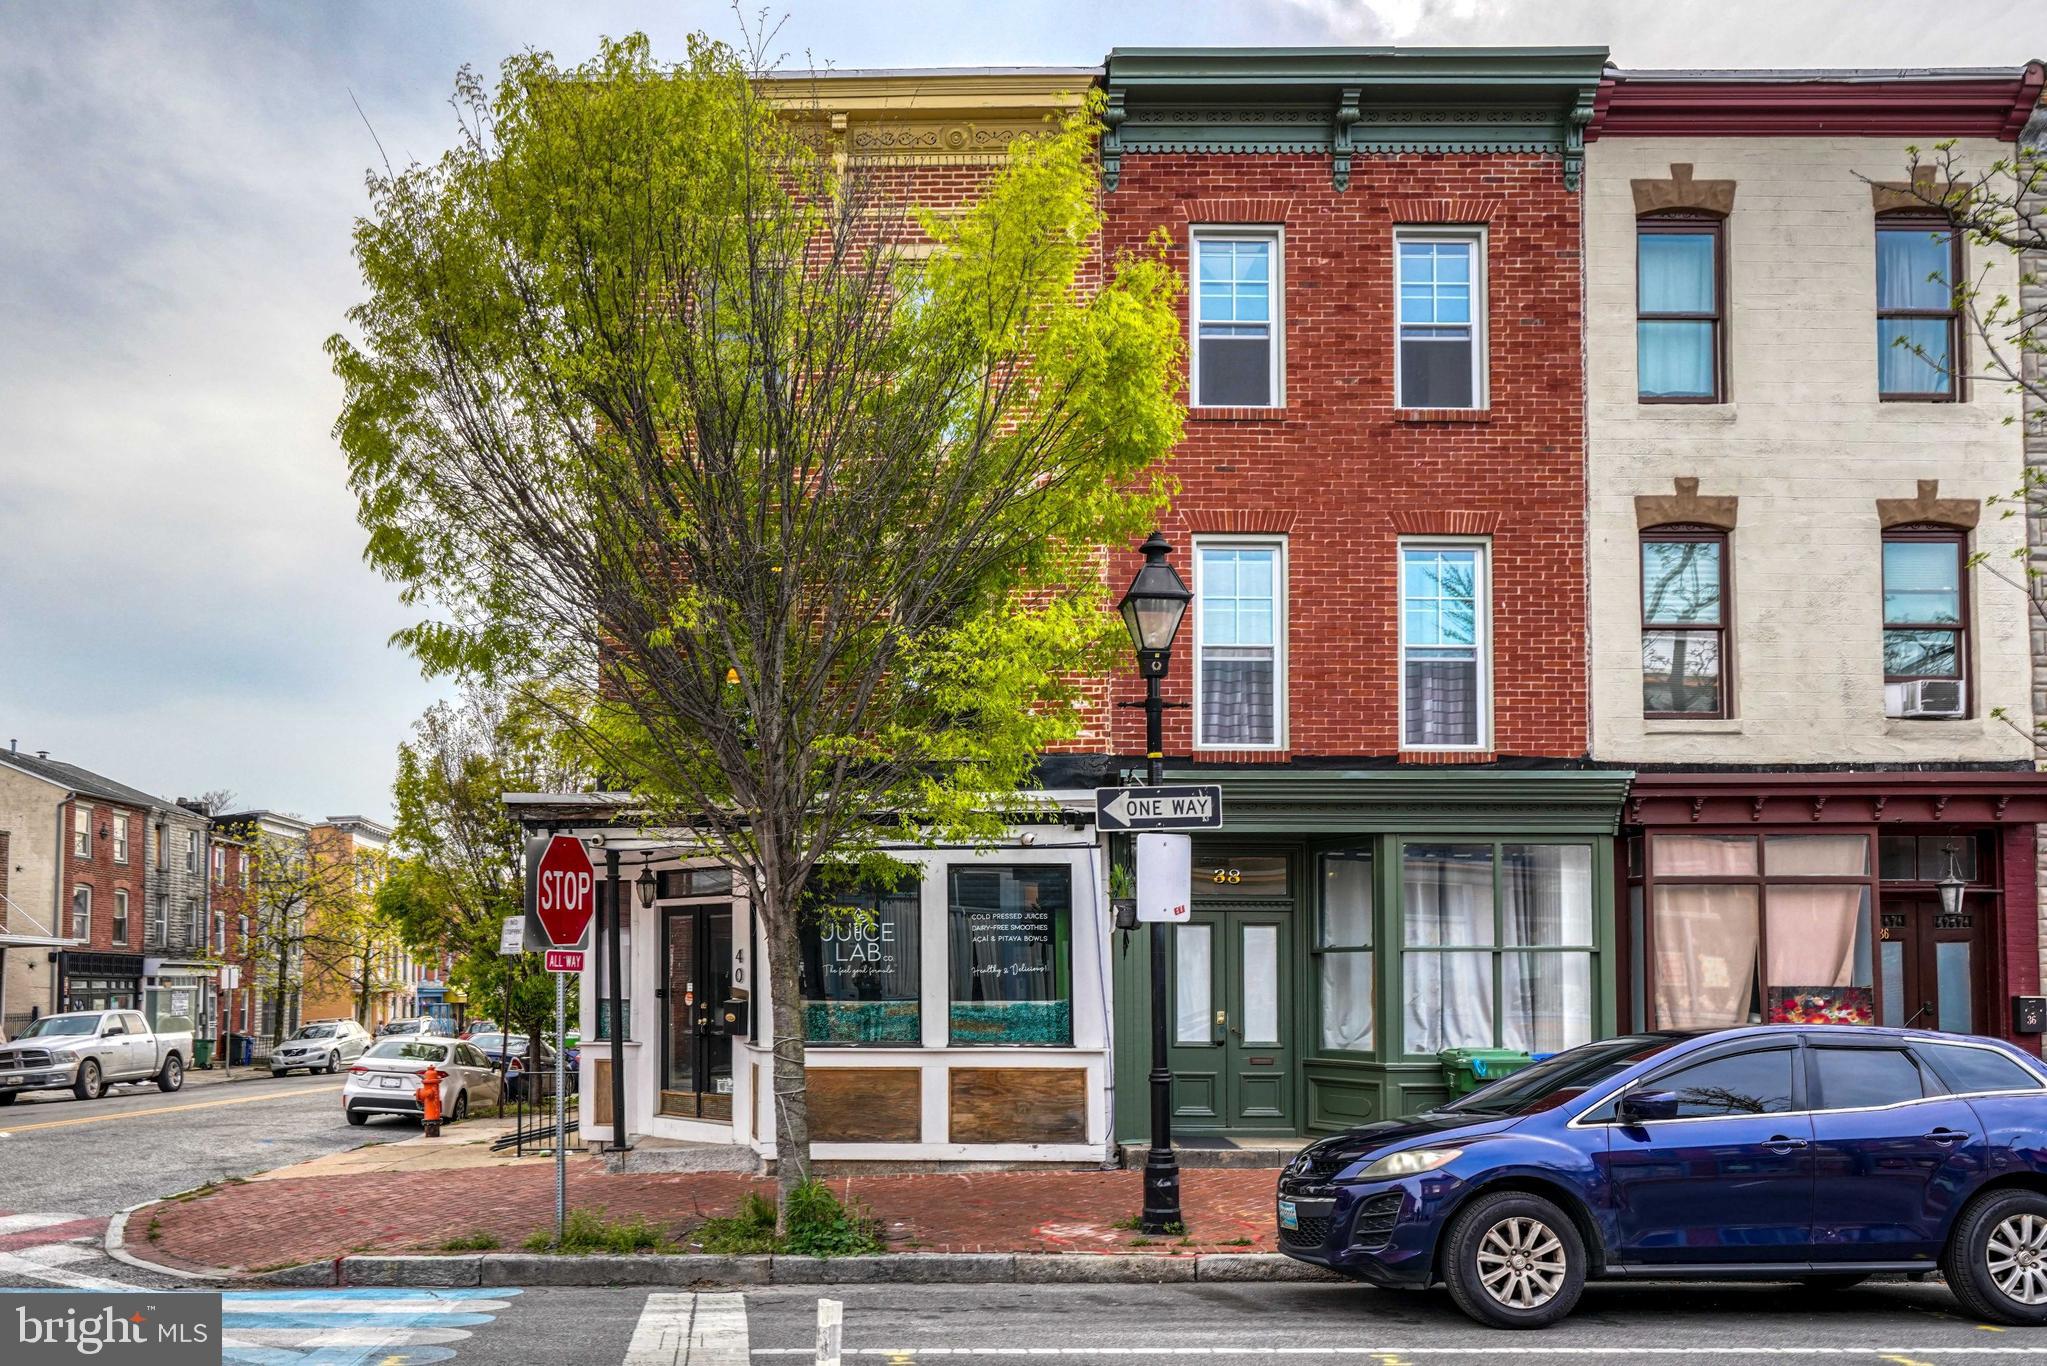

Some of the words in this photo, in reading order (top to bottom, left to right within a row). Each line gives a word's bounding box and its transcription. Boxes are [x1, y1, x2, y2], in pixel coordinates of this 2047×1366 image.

[1126, 800, 1163, 816] ONE
[1172, 799, 1208, 815] WAY
[1214, 869, 1241, 884] 38
[541, 870, 590, 910] STOP
[971, 913, 991, 921] COLD
[1024, 912, 1048, 920] JUICES
[820, 922, 895, 941] JUICE
[836, 943, 881, 962] LAB
[549, 955, 563, 967] ALL
[565, 955, 581, 968] WAY
[822, 964, 837, 976] The
[971, 964, 1001, 978] Healthy
[2026, 1015, 2037, 1024] 36
